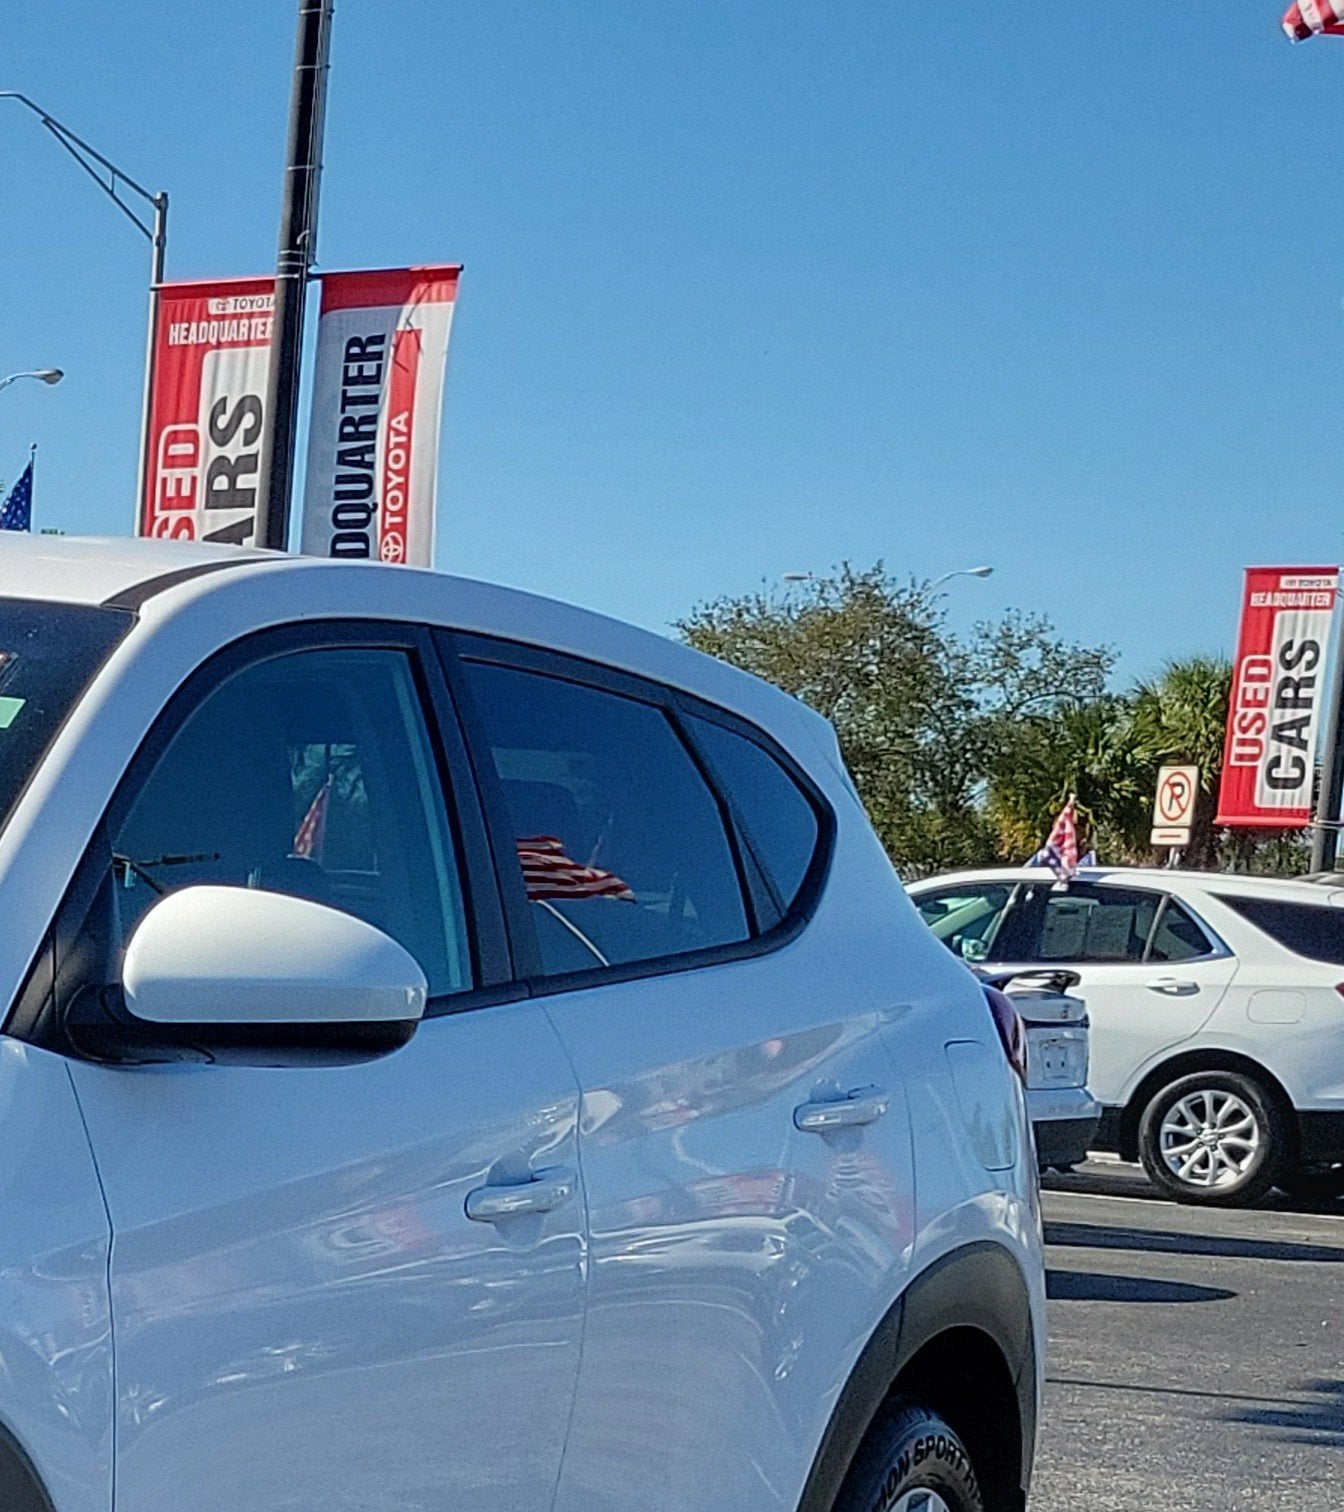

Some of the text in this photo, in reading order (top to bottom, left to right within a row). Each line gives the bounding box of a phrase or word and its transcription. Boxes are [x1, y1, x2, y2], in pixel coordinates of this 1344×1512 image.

[233, 297, 274, 310] TOYOT
[384, 410, 410, 529] TOYOTA
[1232, 656, 1273, 767] USED
[1265, 638, 1321, 791] CARS
[913, 1434, 971, 1471] SPORT
